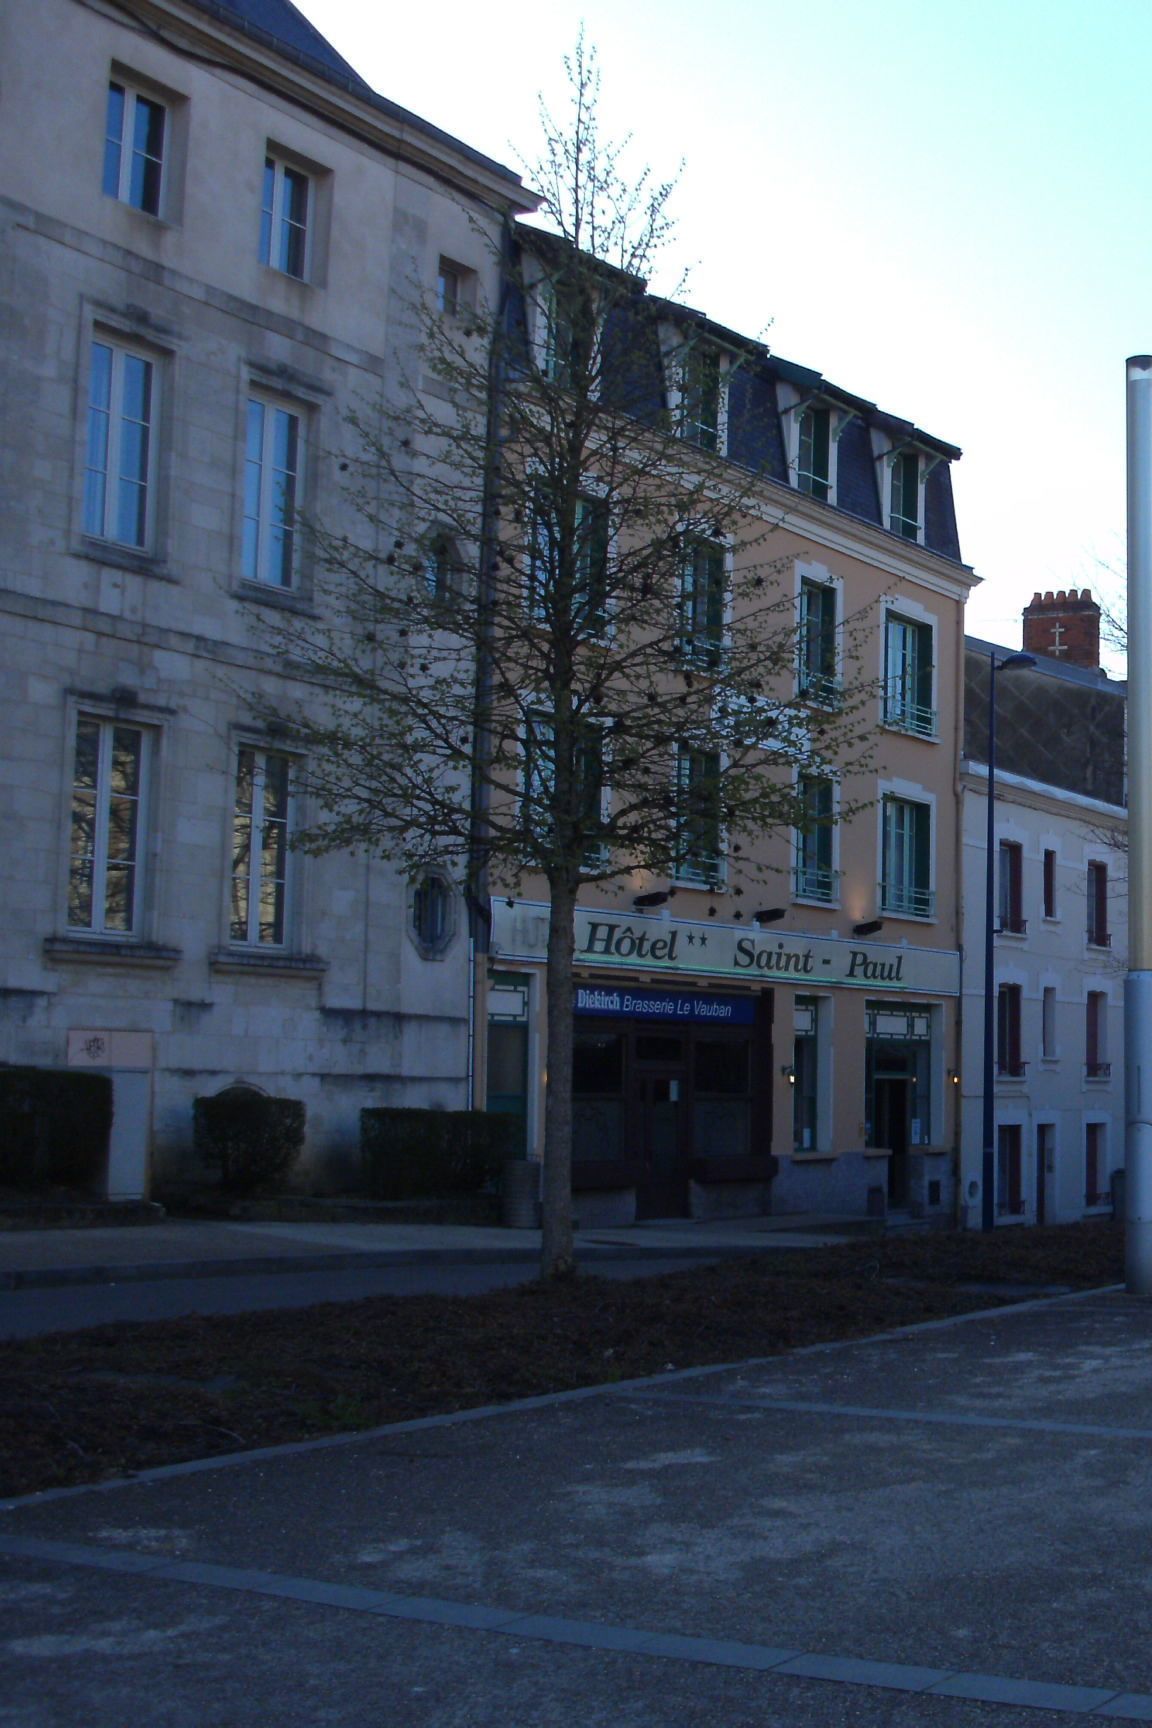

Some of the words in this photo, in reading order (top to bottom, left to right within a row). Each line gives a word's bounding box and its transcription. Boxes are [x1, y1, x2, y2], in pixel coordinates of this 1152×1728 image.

[579, 921, 678, 961] Hôtel
[734, 937, 814, 974] Saint
[845, 950, 904, 983] Paul
[577, 989, 620, 1010] Diekirch
[622, 995, 674, 1014] Brasserie
[677, 999, 691, 1015] Le
[693, 1000, 732, 1017] Vauban
